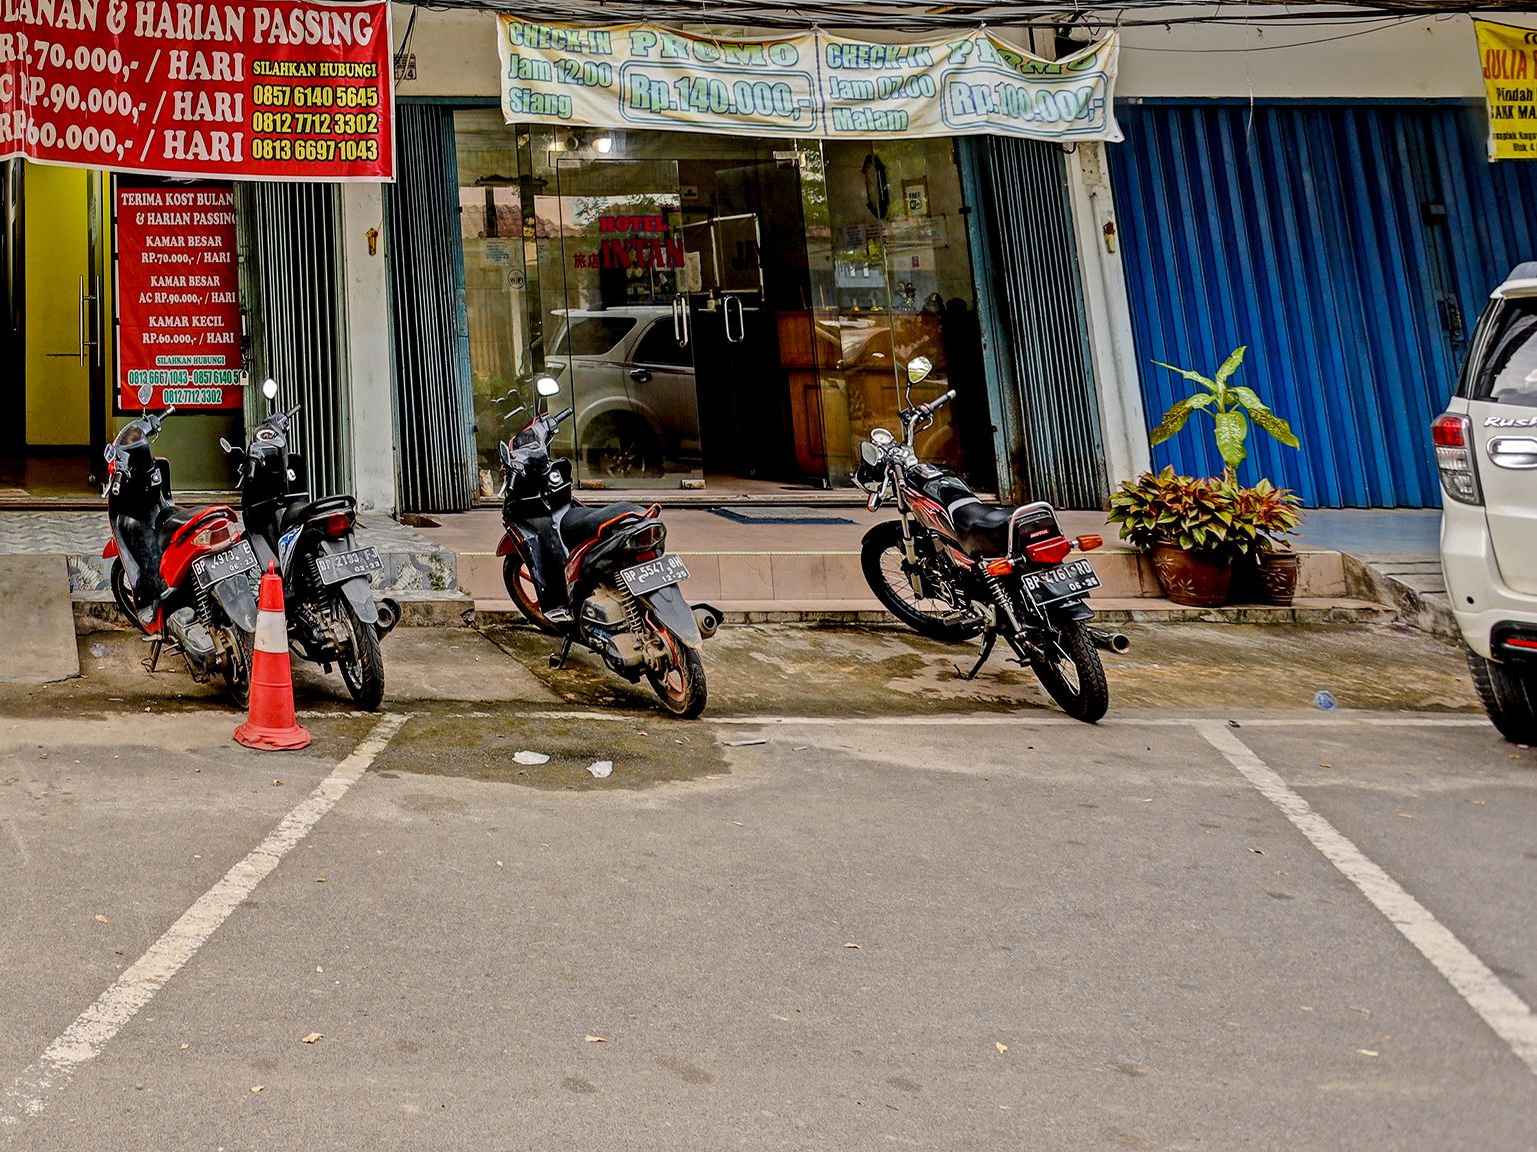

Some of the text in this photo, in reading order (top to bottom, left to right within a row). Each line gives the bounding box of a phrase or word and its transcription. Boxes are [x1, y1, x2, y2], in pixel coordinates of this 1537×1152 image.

[134, 0, 246, 43] HARIAN
[253, 6, 374, 47] PASSING
[508, 21, 613, 55] CHECK-IN
[629, 30, 799, 67] PROMO
[168, 49, 245, 83] HARI
[825, 42, 935, 70] CHECK-IN
[1483, 48, 1527, 80] JULIA
[252, 61, 378, 79] SILAHKAN HUBUNGI
[509, 53, 613, 88] Jam 12.00
[252, 84, 378, 107] 0857 6140 5645
[629, 73, 813, 121] Rp.140.000,-
[829, 73, 936, 101] Jam 07.00
[1496, 87, 1533, 102] Pindah
[173, 90, 244, 123] HARI
[509, 87, 573, 119] Siang
[252, 111, 378, 135] 0812 7712 3302
[831, 107, 909, 132] Malam
[163, 130, 243, 163] HARI
[252, 138, 378, 161] 0813 6697 1043
[121, 193, 163, 206] TERIMA
[165, 193, 194, 206] KOST
[136, 213, 145, 226] &
[147, 213, 191, 225] HARIAN
[599, 215, 669, 232] HOTEL
[146, 236, 222, 247] KAMAR BESAR
[141, 252, 194, 265] RP.70.000,-
[203, 252, 231, 263] HARI
[601, 238, 685, 269] INTAN
[151, 276, 220, 287] KAMAR BESAR
[139, 293, 153, 304] AC
[154, 293, 203, 305] RP.90.000,-
[211, 293, 236, 304] HARI
[149, 316, 225, 327] KAMAR KECIL
[142, 333, 197, 346] RP.60.000,-
[207, 333, 234, 344] HARI
[156, 356, 225, 365] SILAHKAN HUBUNGI
[129, 370, 148, 385] 0813
[149, 370, 169, 385] 6667
[169, 370, 188, 385] 1043
[193, 370, 213, 385] 0857
[213, 370, 232, 385] 6140
[163, 389, 222, 404] 0812 7712 3302
[195, 560, 205, 575] BP
[213, 550, 234, 565] 4973
[623, 561, 664, 582] BP 5547
[1025, 575, 1040, 590] BP
